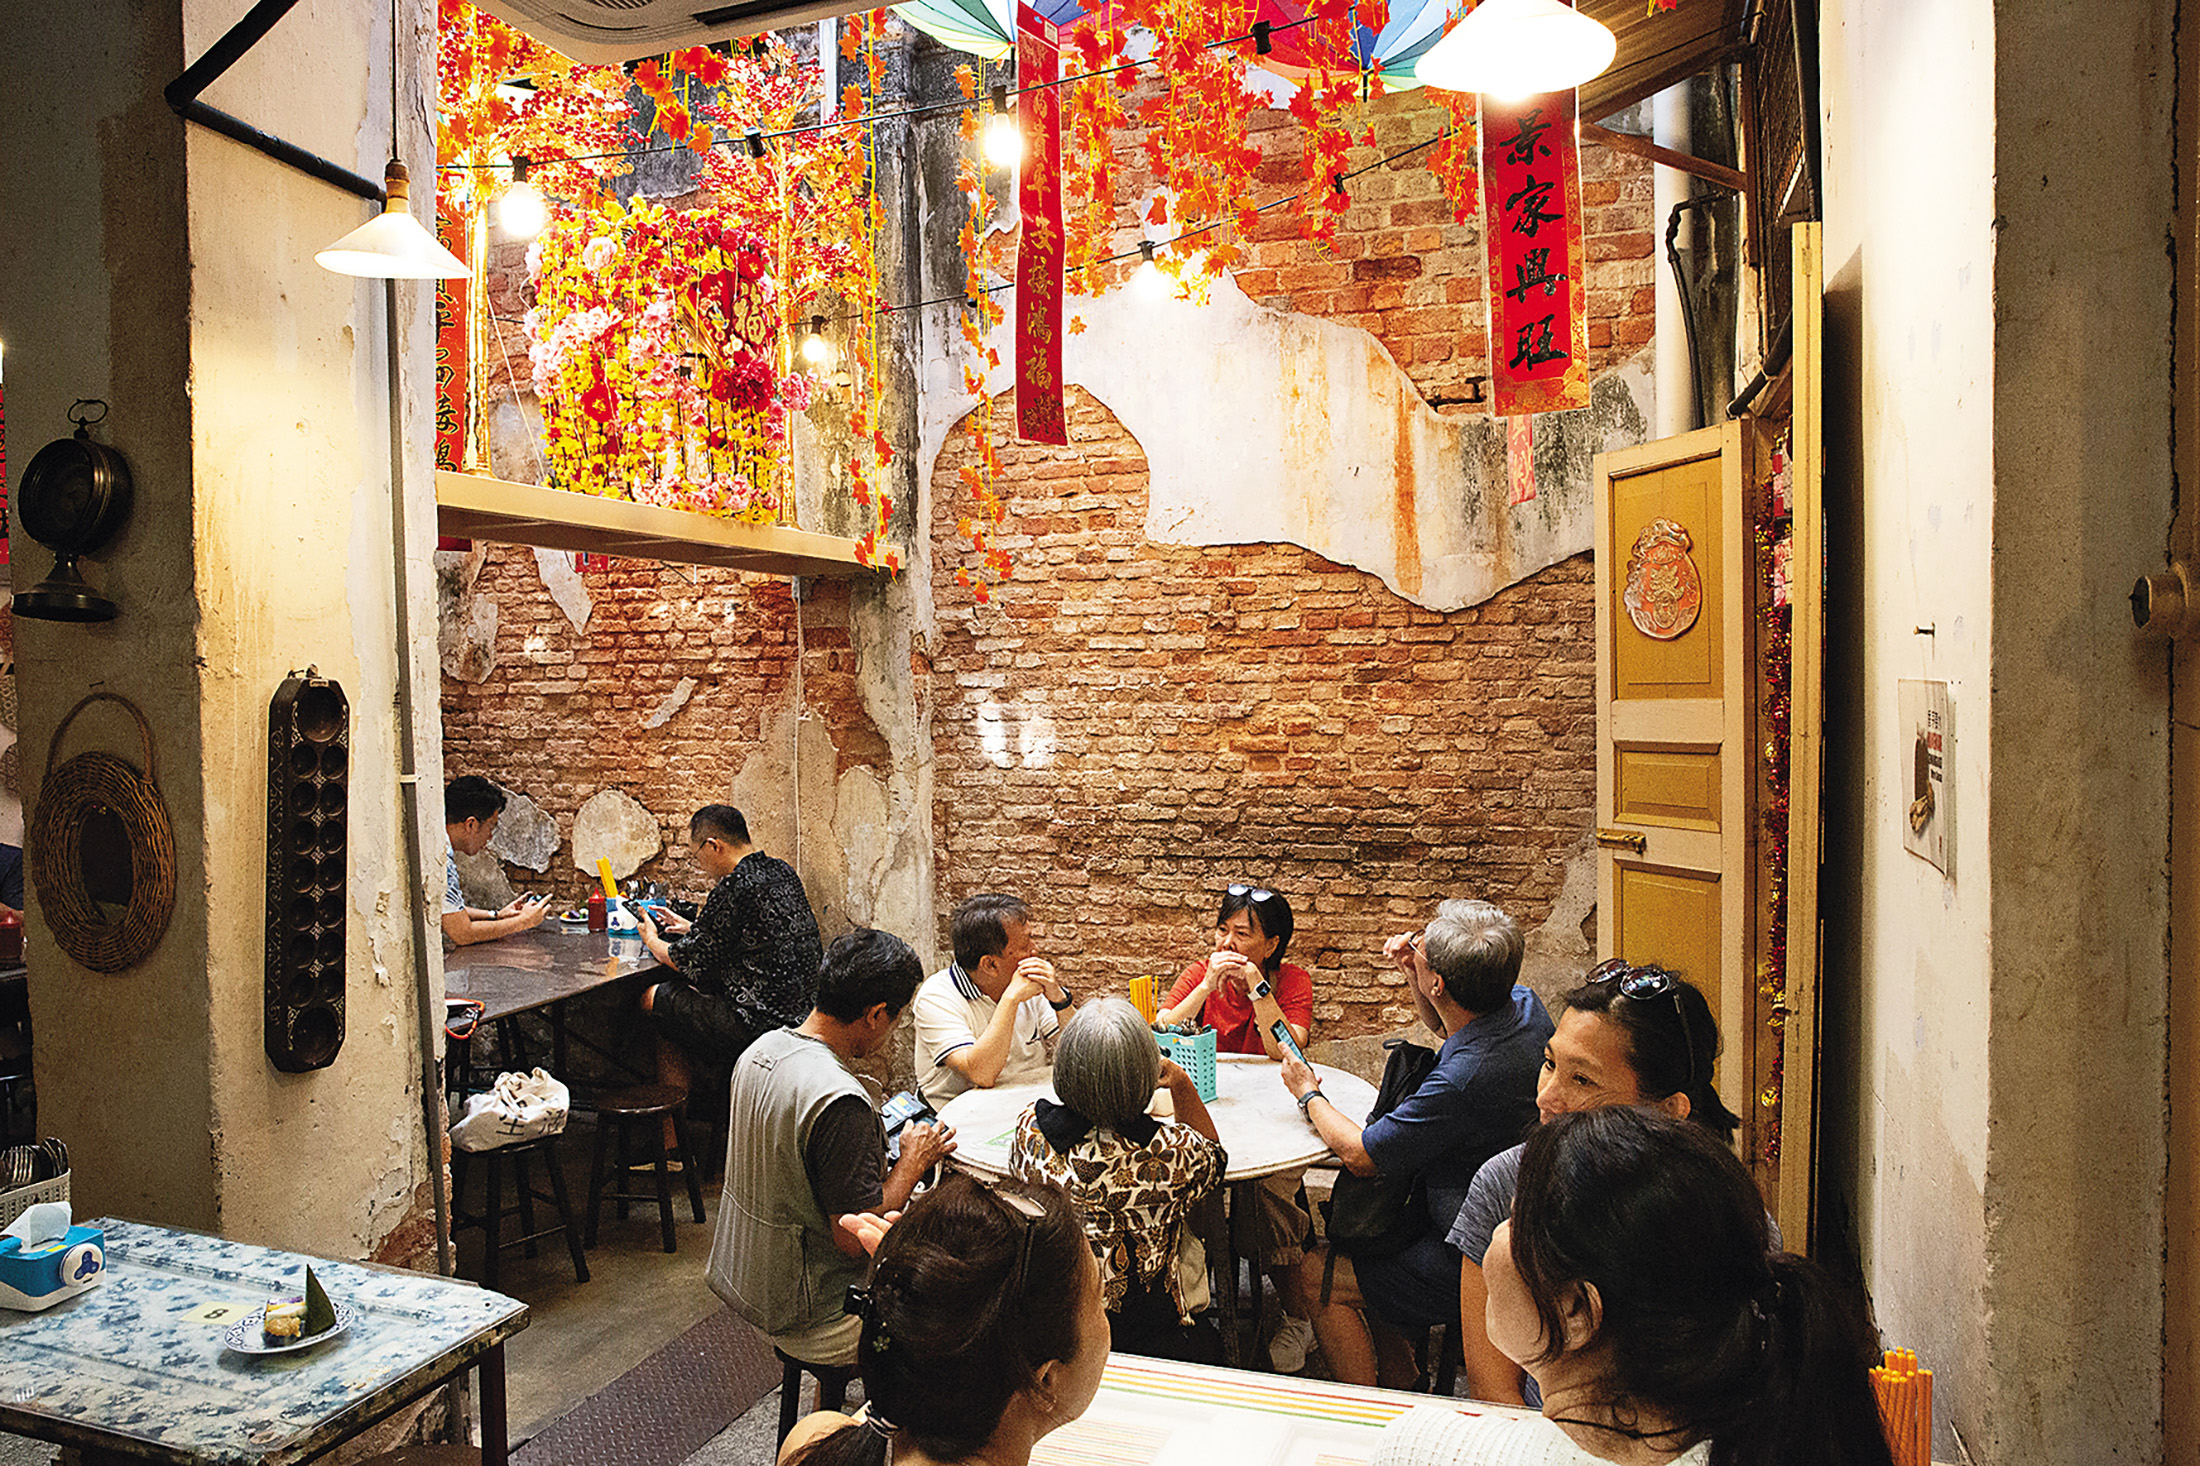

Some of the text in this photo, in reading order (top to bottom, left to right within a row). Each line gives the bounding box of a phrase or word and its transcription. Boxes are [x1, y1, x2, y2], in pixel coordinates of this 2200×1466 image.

[1499, 107, 1569, 372] 景家興旺
[204, 1308, 229, 1319] 8
